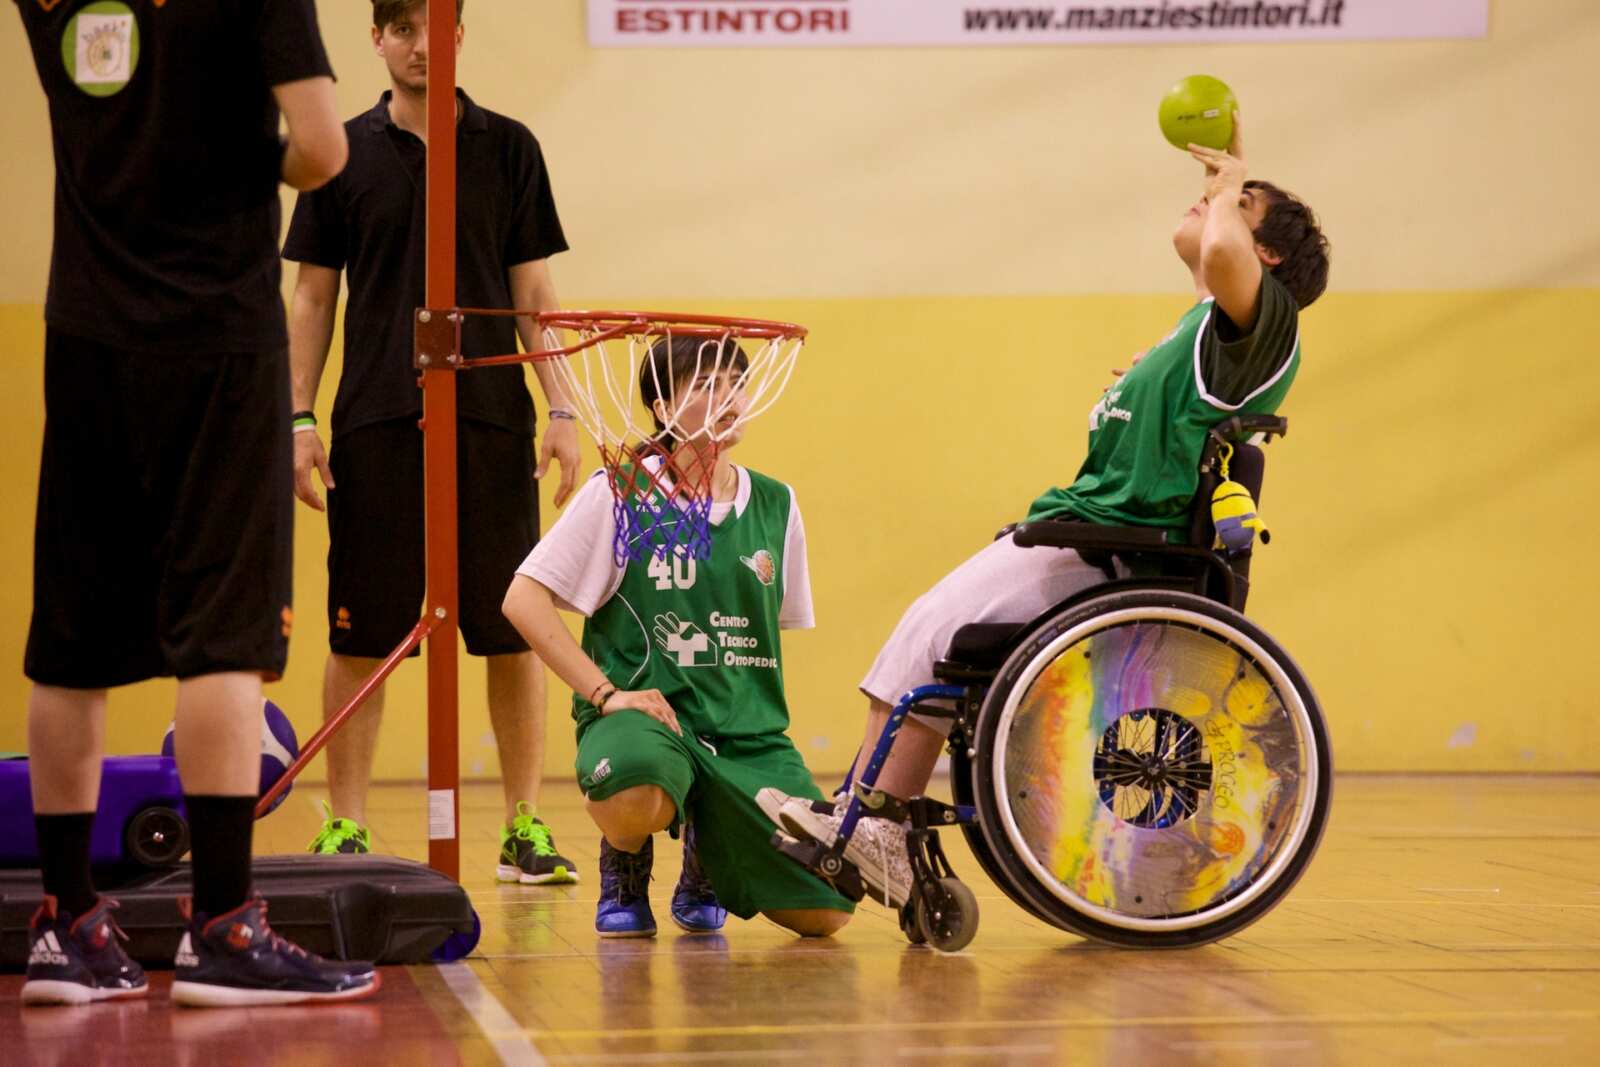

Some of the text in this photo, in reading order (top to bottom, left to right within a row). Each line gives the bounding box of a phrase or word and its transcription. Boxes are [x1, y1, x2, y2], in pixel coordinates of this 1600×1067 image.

[616, 9, 849, 32] ESTINTORI
[963, 0, 1345, 31] www.manziestintori.it
[647, 544, 696, 590] 40
